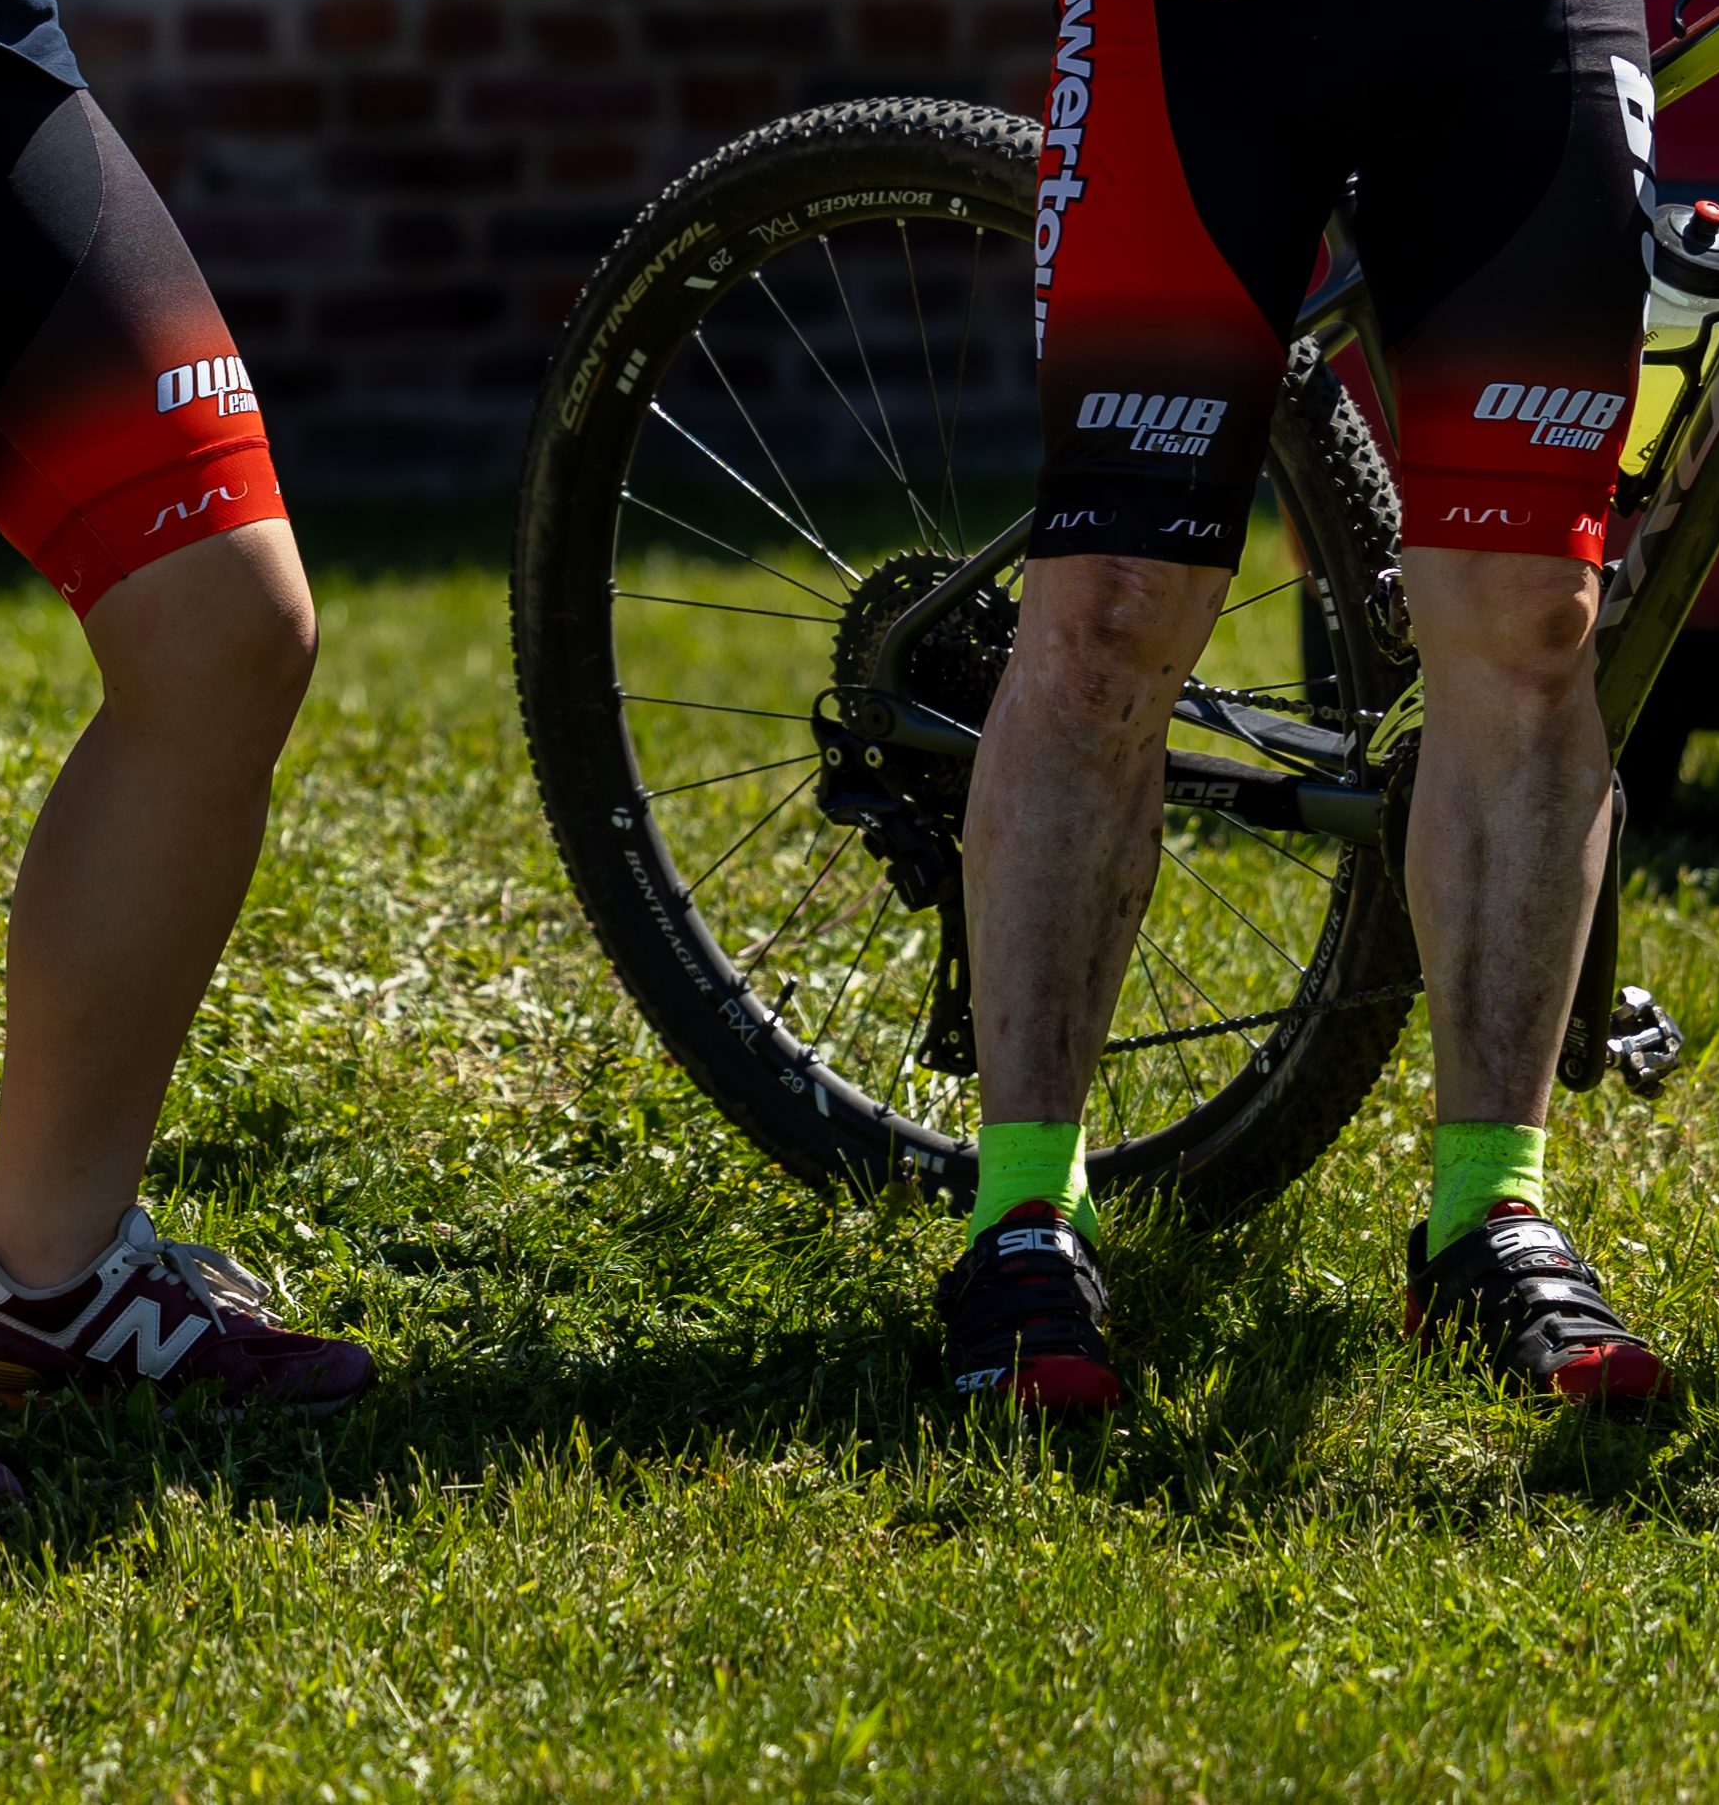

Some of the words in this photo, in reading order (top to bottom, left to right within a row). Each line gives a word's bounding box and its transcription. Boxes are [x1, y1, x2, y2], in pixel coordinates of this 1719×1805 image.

[805, 189, 934, 219] BONTRAGER
[747, 210, 801, 246] RXL
[707, 246, 734, 274] 29
[559, 220, 717, 432] CONTINENTAL
[1075, 391, 1229, 436] OWB
[1472, 382, 1627, 429] OWB
[623, 847, 716, 995] BONTRAGER
[714, 995, 762, 1058] RXL
[776, 1066, 806, 1095] 29
[994, 1226, 1076, 1259] SIDI
[84, 1294, 213, 1381] N
